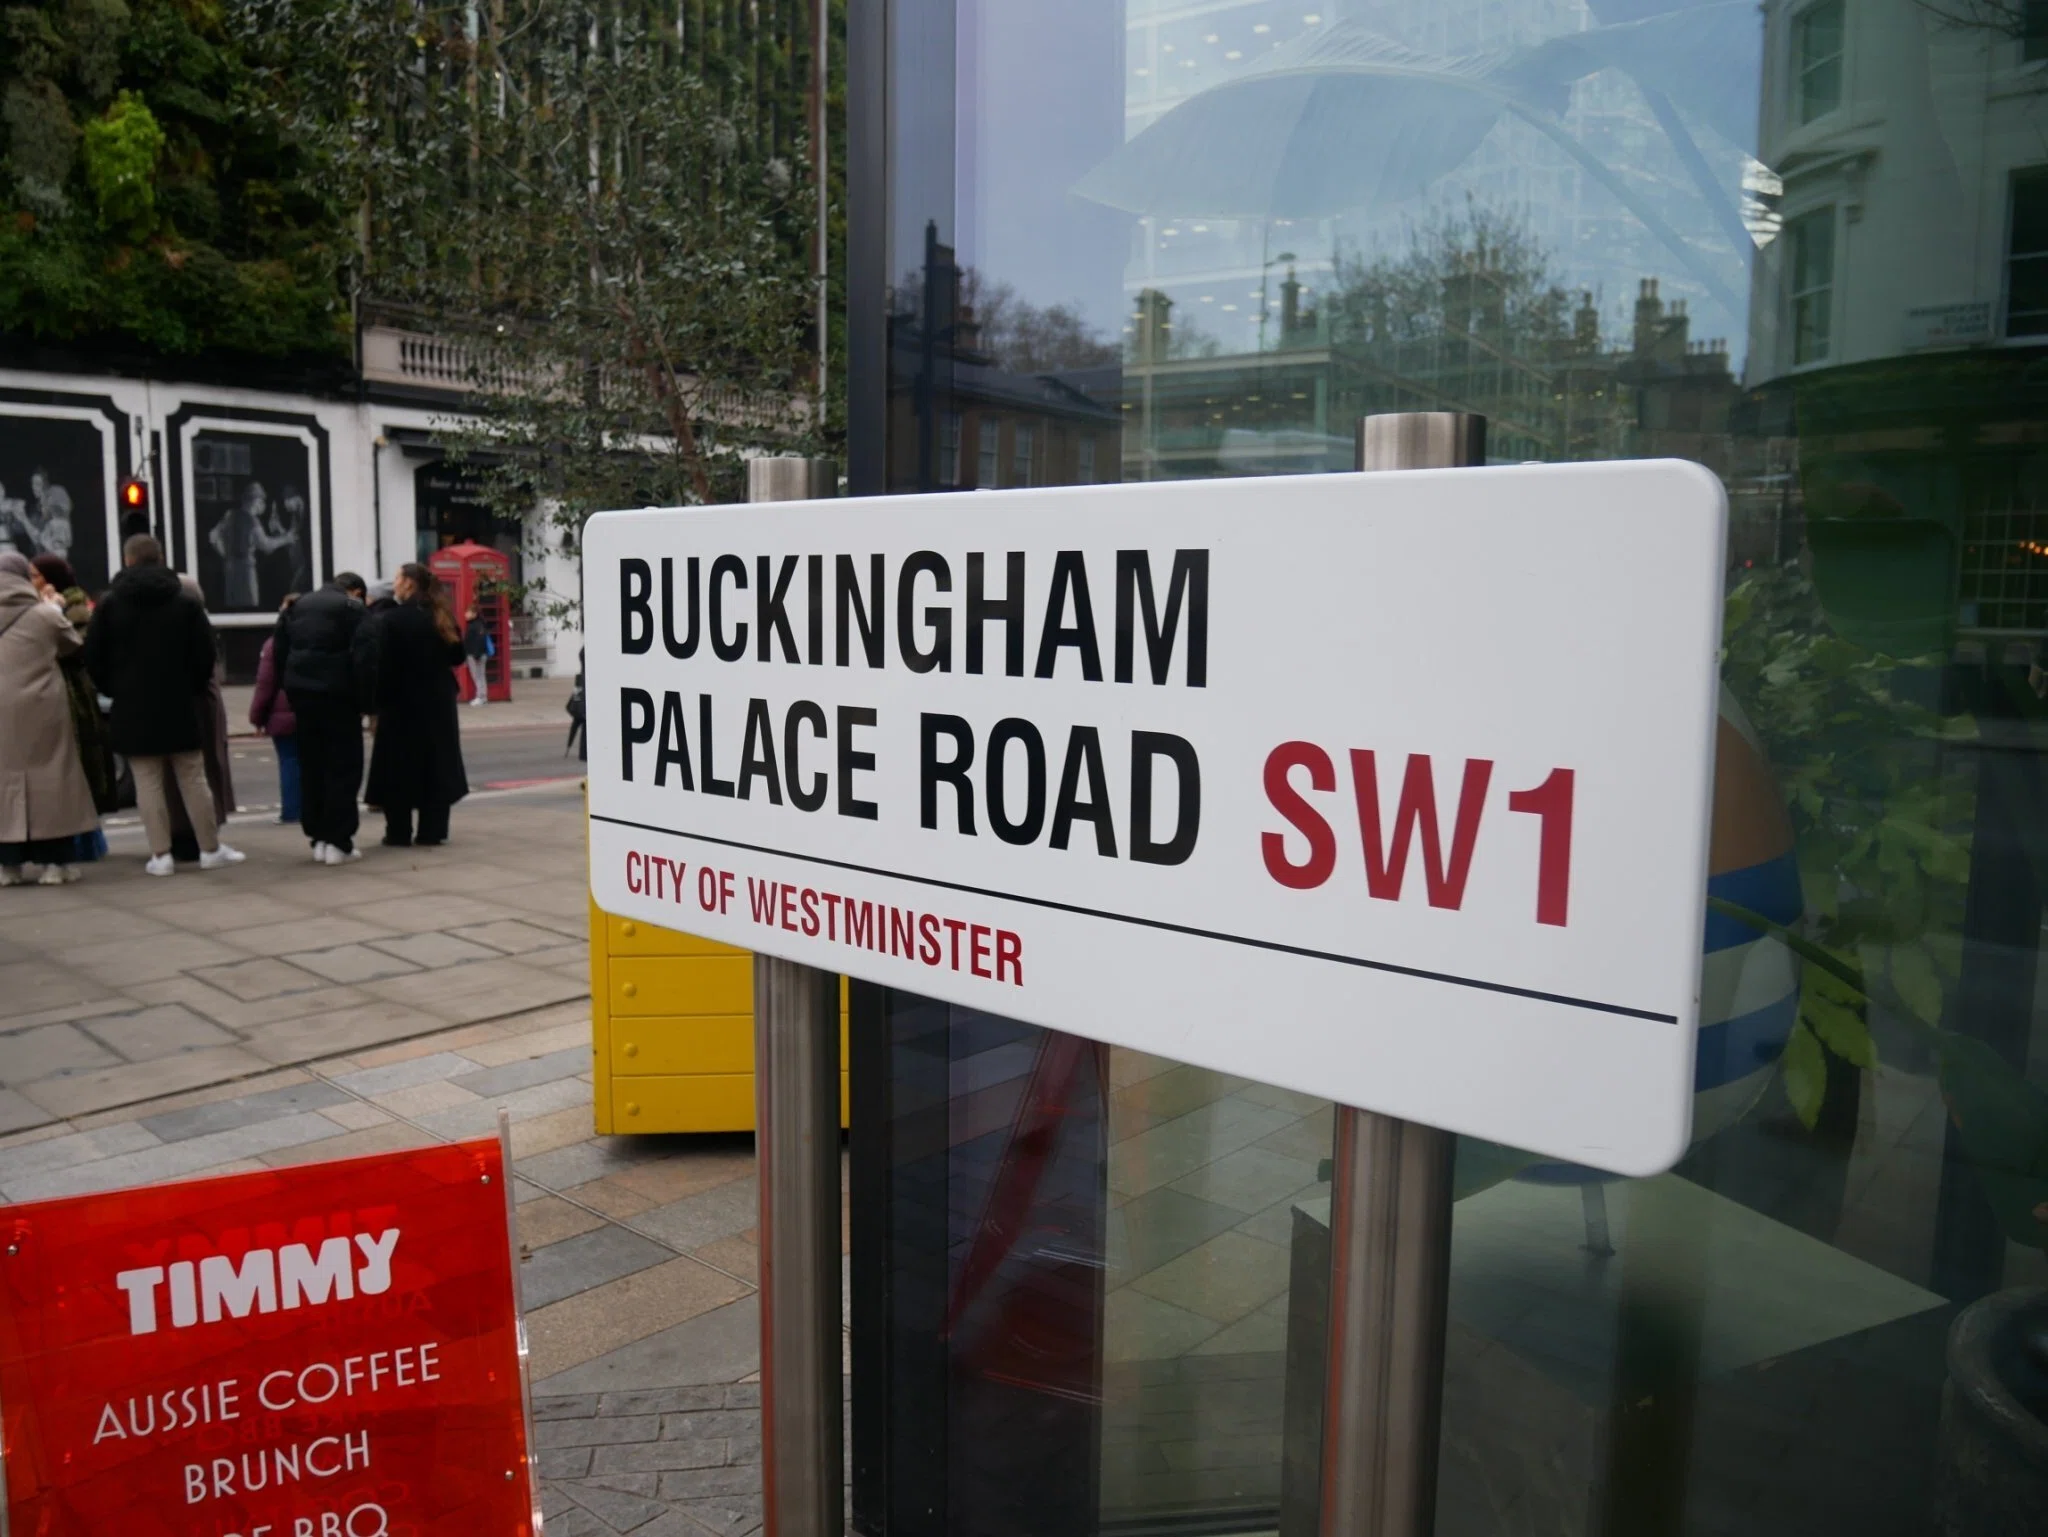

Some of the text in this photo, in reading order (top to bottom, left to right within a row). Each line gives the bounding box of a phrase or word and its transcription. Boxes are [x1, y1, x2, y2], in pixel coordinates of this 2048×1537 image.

[620, 548, 1209, 688] BUCKINGHAM
[620, 687, 1575, 927] PALACE ROAD SW1
[626, 851, 1024, 987] CITY OF WESTMINSTER
[116, 1228, 400, 1336] TIMMY
[93, 1379, 240, 1444] AUSSIE
[258, 1342, 440, 1411] COFFEE
[184, 1430, 371, 1504] BRUNCH
[294, 1503, 388, 1537] BBQ
